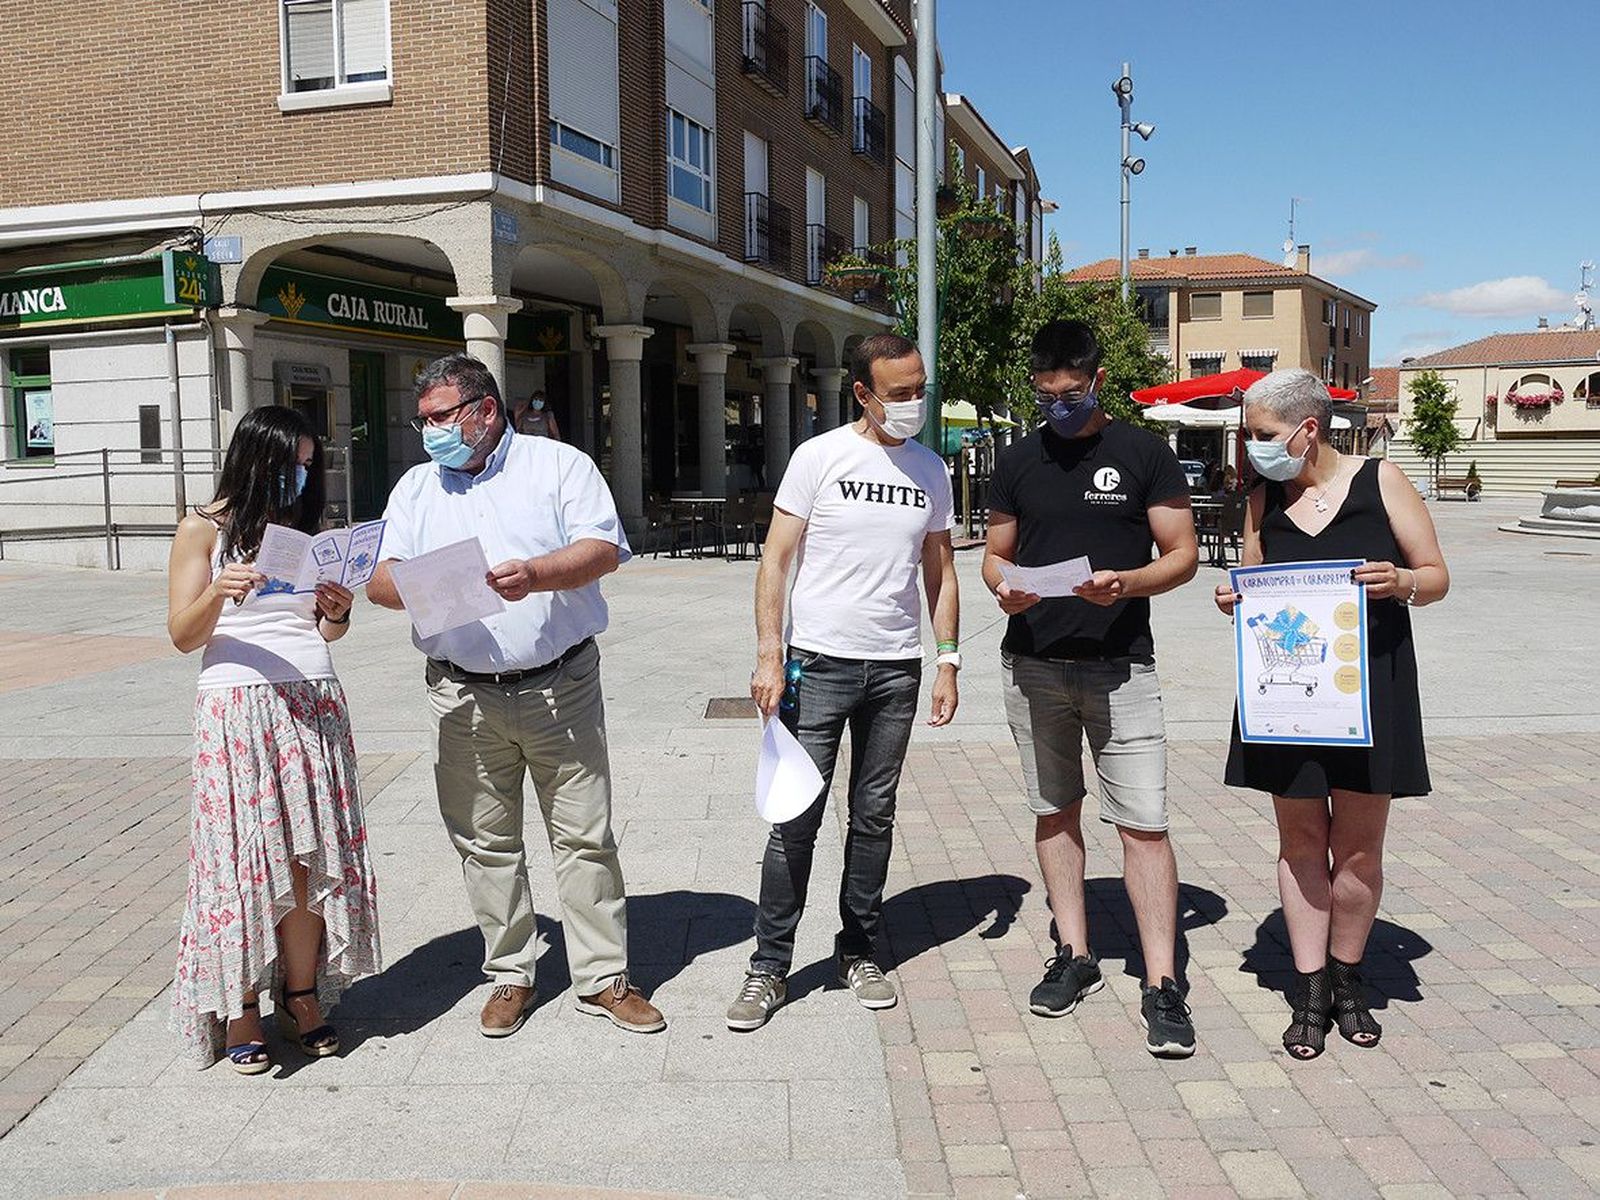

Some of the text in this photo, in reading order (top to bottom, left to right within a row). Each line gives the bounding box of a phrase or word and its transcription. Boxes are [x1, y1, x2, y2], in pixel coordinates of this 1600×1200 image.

[327, 293, 429, 330] CAJA RURAL
[838, 480, 927, 509] WHITE
